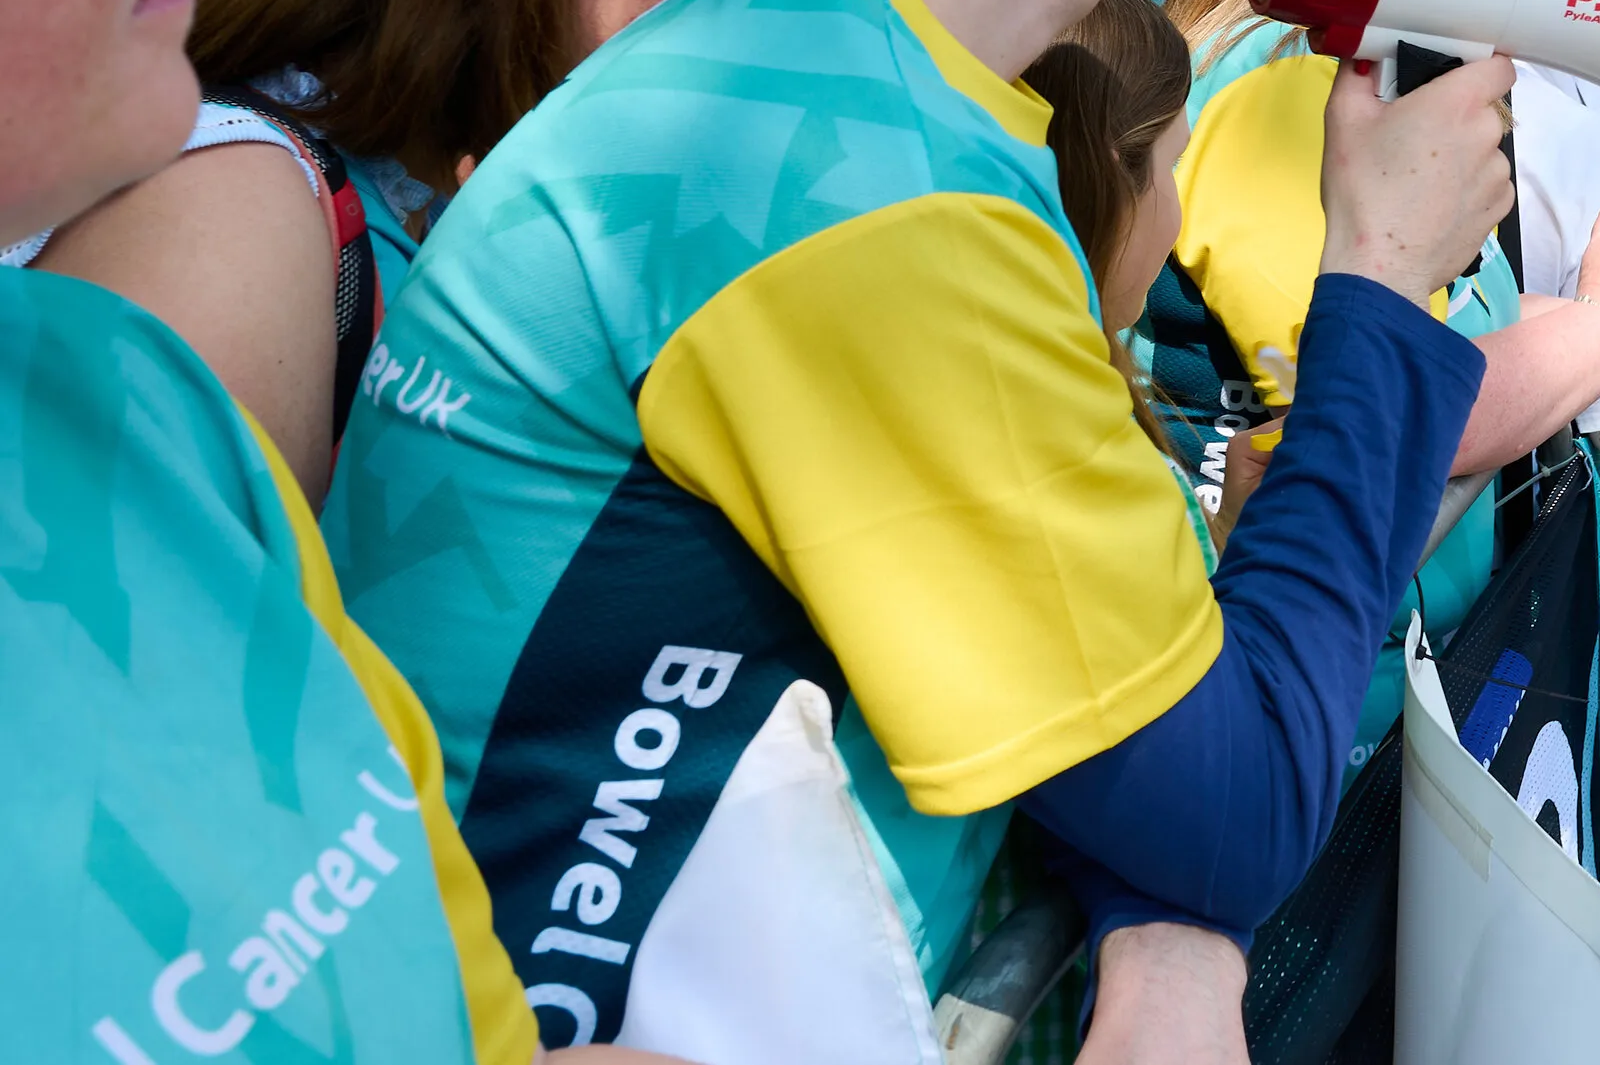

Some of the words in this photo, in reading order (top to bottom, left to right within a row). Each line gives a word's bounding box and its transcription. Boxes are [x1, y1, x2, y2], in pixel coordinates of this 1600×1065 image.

[396, 355, 472, 431] UK
[1194, 379, 1268, 515] Bowe
[531, 644, 743, 966] Bowel
[151, 810, 400, 1057] Cancer
